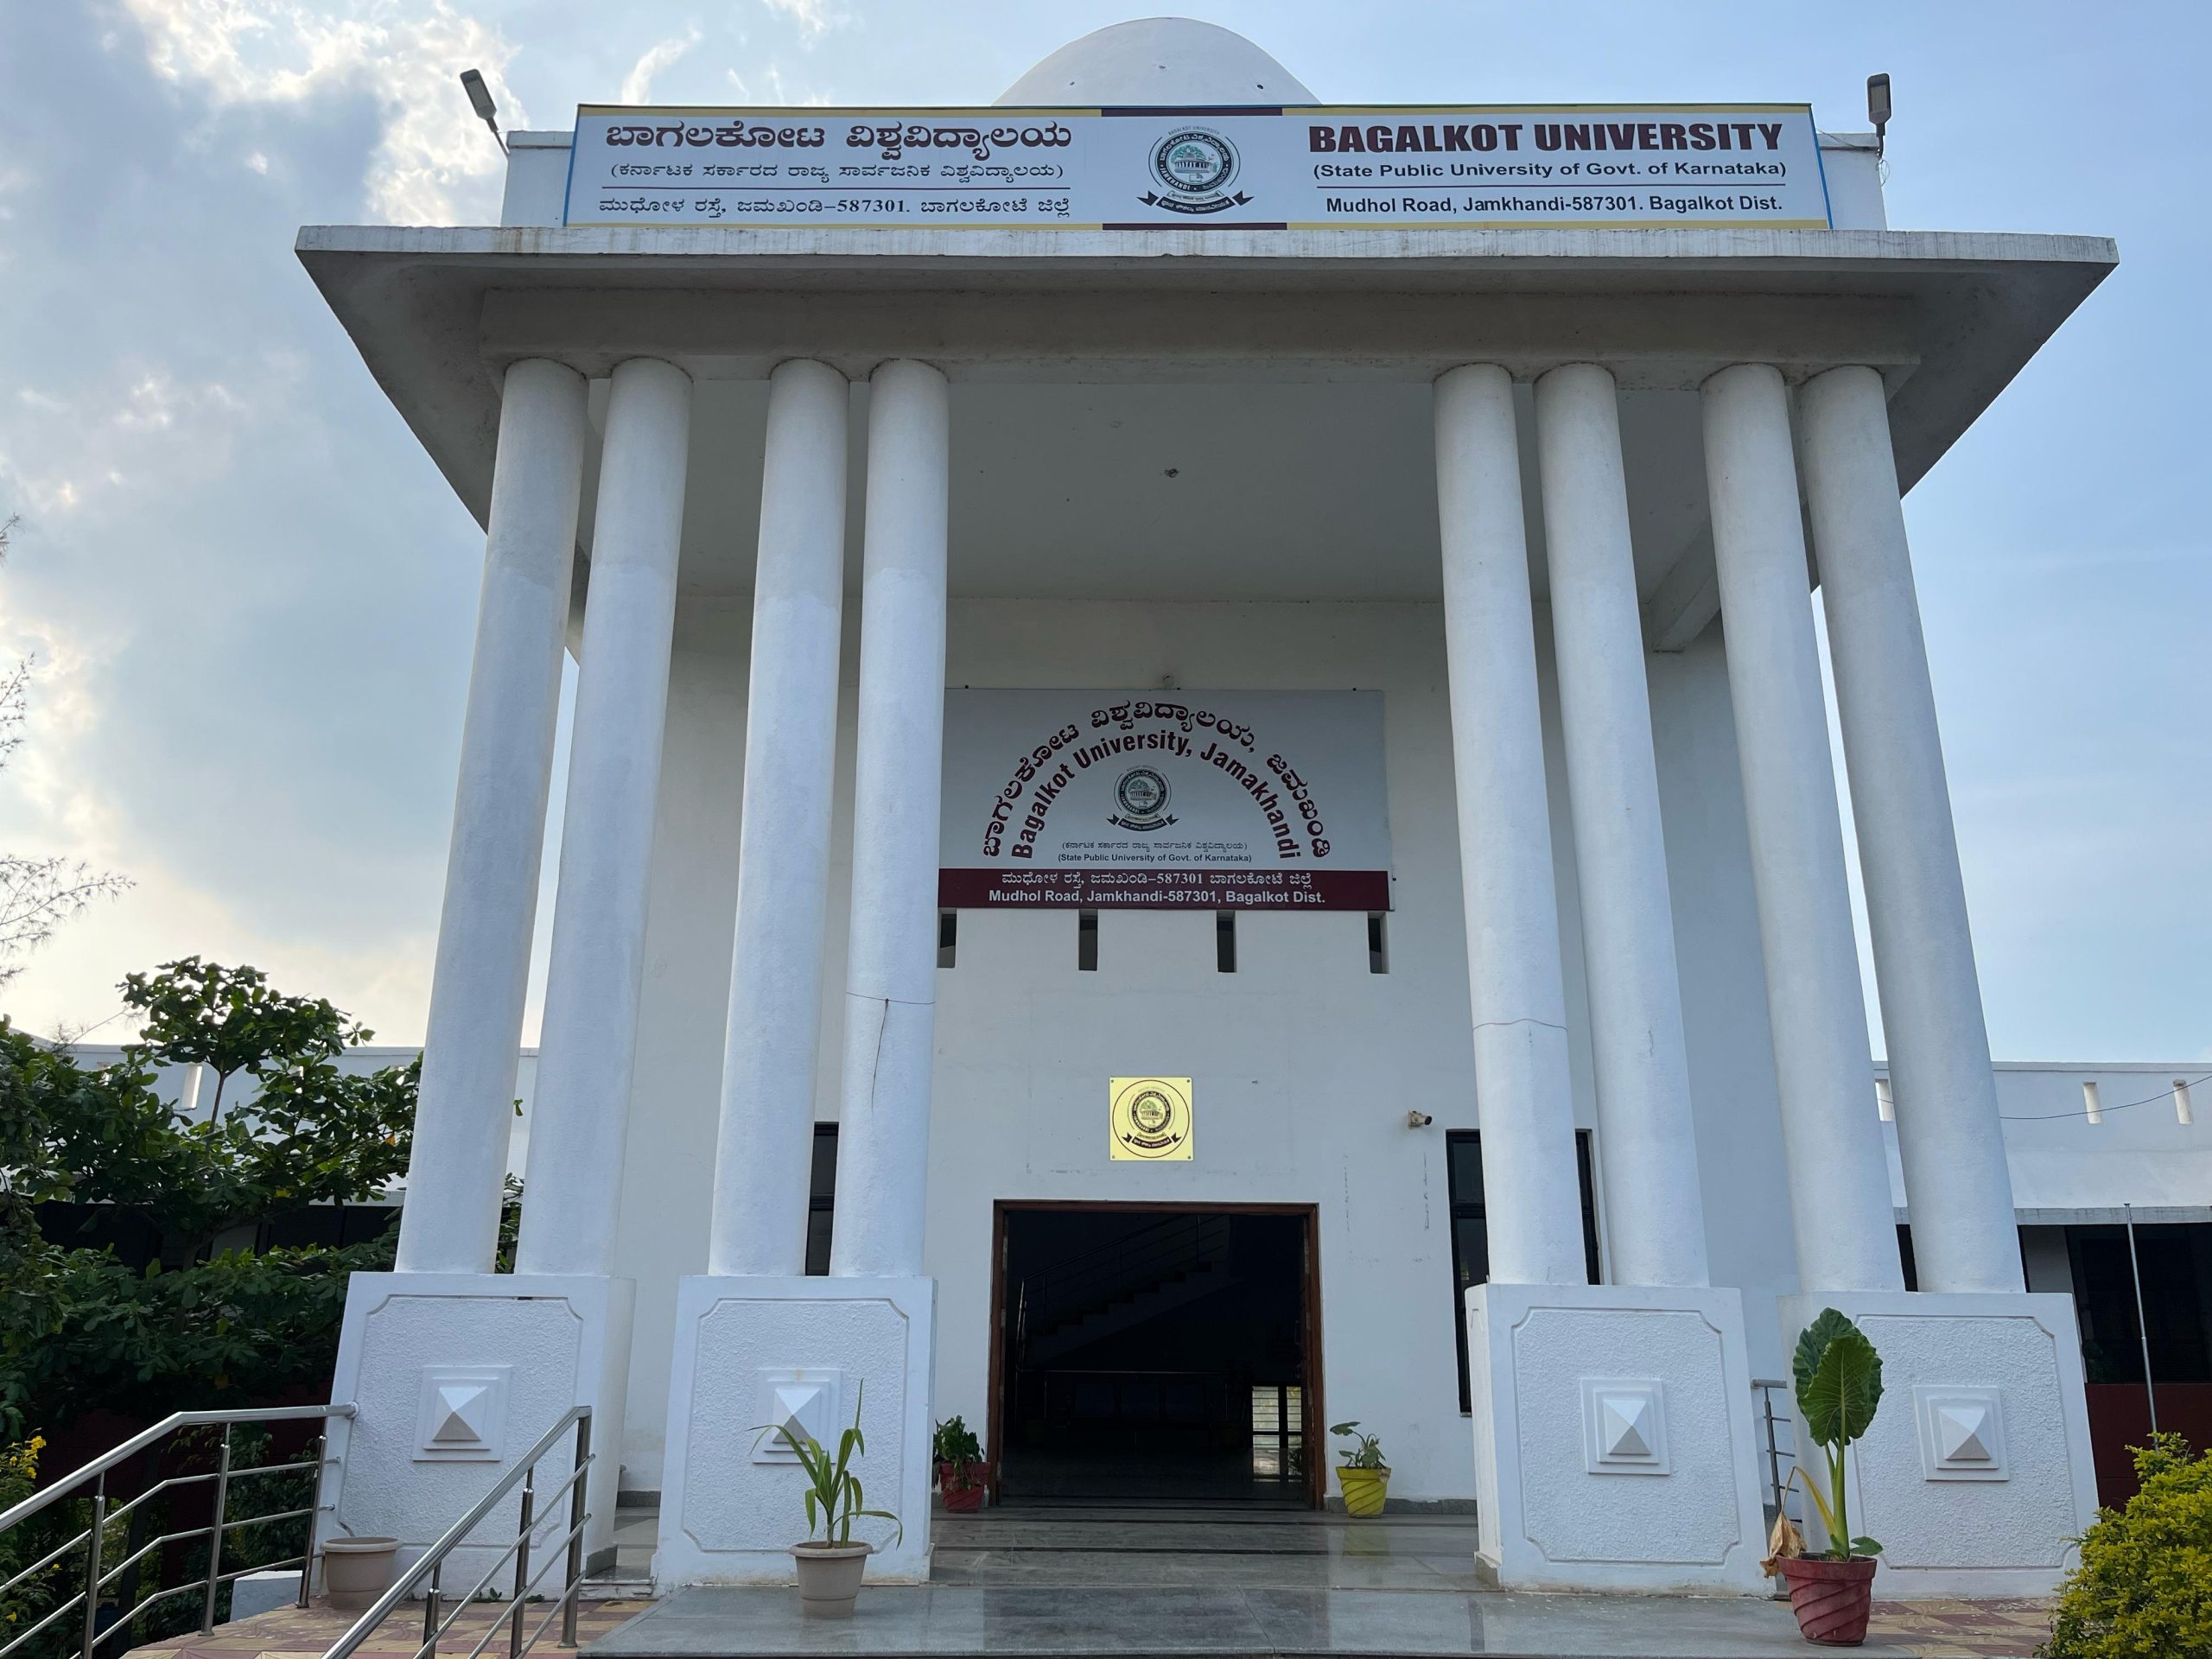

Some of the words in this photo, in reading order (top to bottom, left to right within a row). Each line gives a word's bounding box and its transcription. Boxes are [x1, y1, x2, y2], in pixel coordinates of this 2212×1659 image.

[606, 119, 824, 148] ಬಾಗಲಕೋಟ
[846, 120, 1072, 162] ವಿಶ್ವವಿದ್ಯಾಲಯ
[1309, 124, 1522, 153] BAGALKOT
[1534, 123, 1783, 151] UNIVERSITY
[611, 163, 693, 178] (ಕರ್ನಾಟಕ
[702, 163, 778, 177] ಸರ್ಕಾರದ
[788, 163, 830, 183] ರಾಜ್ಯ
[839, 164, 931, 177] ಸಾರ್ವಜನಿಕ
[940, 163, 1064, 183] ವಿಶ್ವವಿದ್ಯಾಲಯ)
[1313, 164, 1373, 180] (State
[1380, 163, 1444, 177] Public
[1450, 163, 1553, 179] University
[1560, 162, 1580, 175] of
[1586, 162, 1642, 175] Govt.
[1648, 162, 1669, 175] of
[1675, 162, 1787, 177] Karnataka)
[599, 197, 684, 214] ಮುಧೋಳ
[921, 197, 1027, 213] ಬಾಗಲಕೋಟೆ
[1039, 198, 1071, 218] ಜಿಲ್ಲೆ
[1326, 198, 1396, 213] Mudhol
[1402, 197, 1458, 214] Road,
[1463, 195, 1643, 213] Jamkhandi-587301.
[1649, 195, 1734, 214] Bagalkot
[1739, 195, 1783, 210] Dist.
[982, 724, 1079, 857] ಬಾಗಲಕೋಟ
[1267, 753, 1331, 857] ಜಮಖಂಡಿ
[1011, 763, 1075, 859] Bagalkot
[1073, 729, 1192, 769] University,
[1200, 742, 1300, 859] Jamakhandi
[1058, 854, 1081, 862] (State
[1112, 854, 1154, 862] University
[1169, 854, 1192, 862] Govt.
[1205, 854, 1252, 862] Karnataka)
[1001, 872, 1058, 885] ಮುಧೋಳ
[1211, 873, 1282, 885] ಬಾಗಲಕೋಟೆ
[1289, 873, 1312, 889] ಜಿಲ್ಲೆ
[988, 890, 1040, 901] Mudhol
[1045, 890, 1083, 903] Road,
[1087, 890, 1221, 904] Jamkhandi-587301,
[1226, 891, 1288, 905] Bagalkot
[1293, 891, 1325, 903] Dist.
